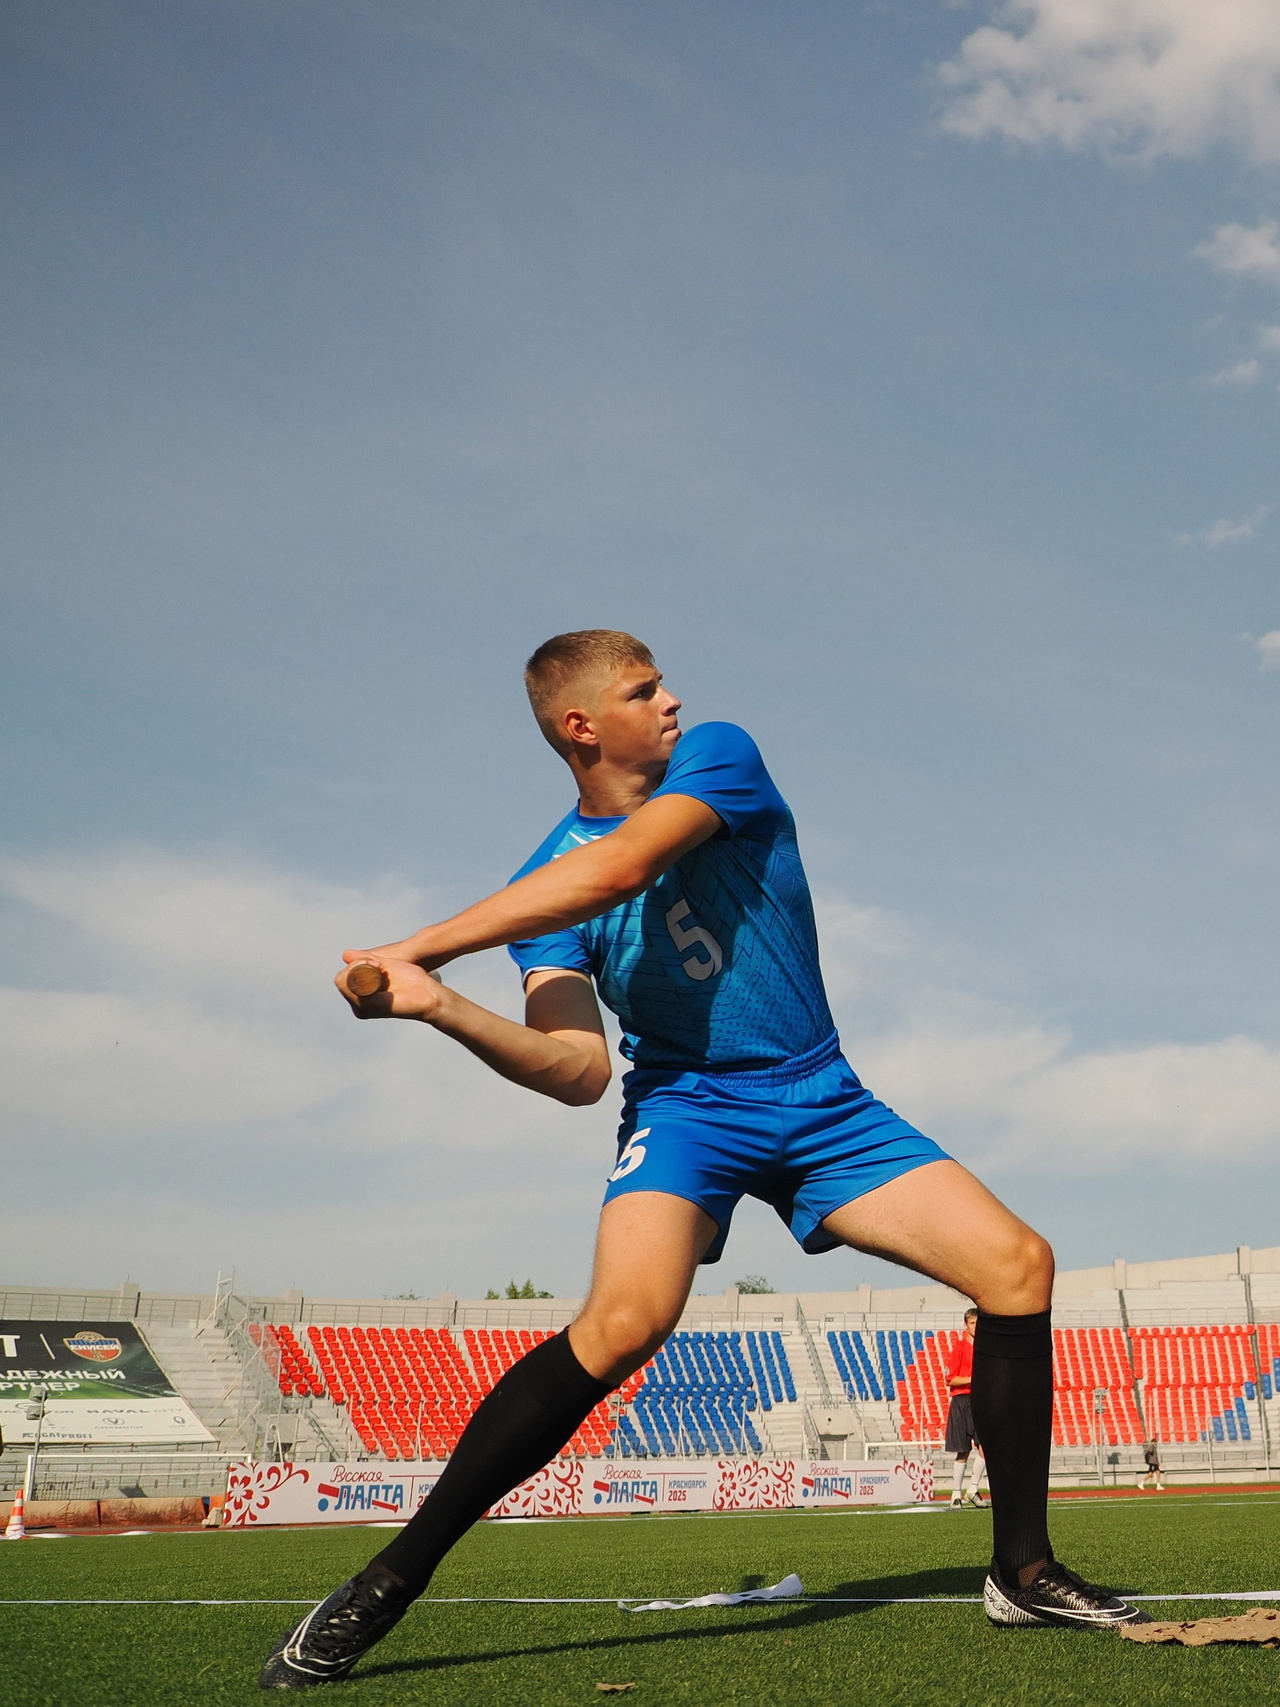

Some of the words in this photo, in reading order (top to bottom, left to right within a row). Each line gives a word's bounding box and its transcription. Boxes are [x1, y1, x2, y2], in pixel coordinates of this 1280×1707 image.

[664, 897, 723, 982] 5
[606, 1126, 652, 1183] 5
[329, 1464, 384, 1483] Русская
[859, 1475, 890, 1485] КРАСНОЯРСК
[606, 1480, 658, 1504] ЛАПТА
[668, 1480, 707, 1490] КРАСНОЯРСК
[812, 1476, 852, 1497] ЛАПТА
[859, 1485, 874, 1496] 2025
[333, 1484, 404, 1511] ЛАПТА
[668, 1490, 687, 1501] 2025
